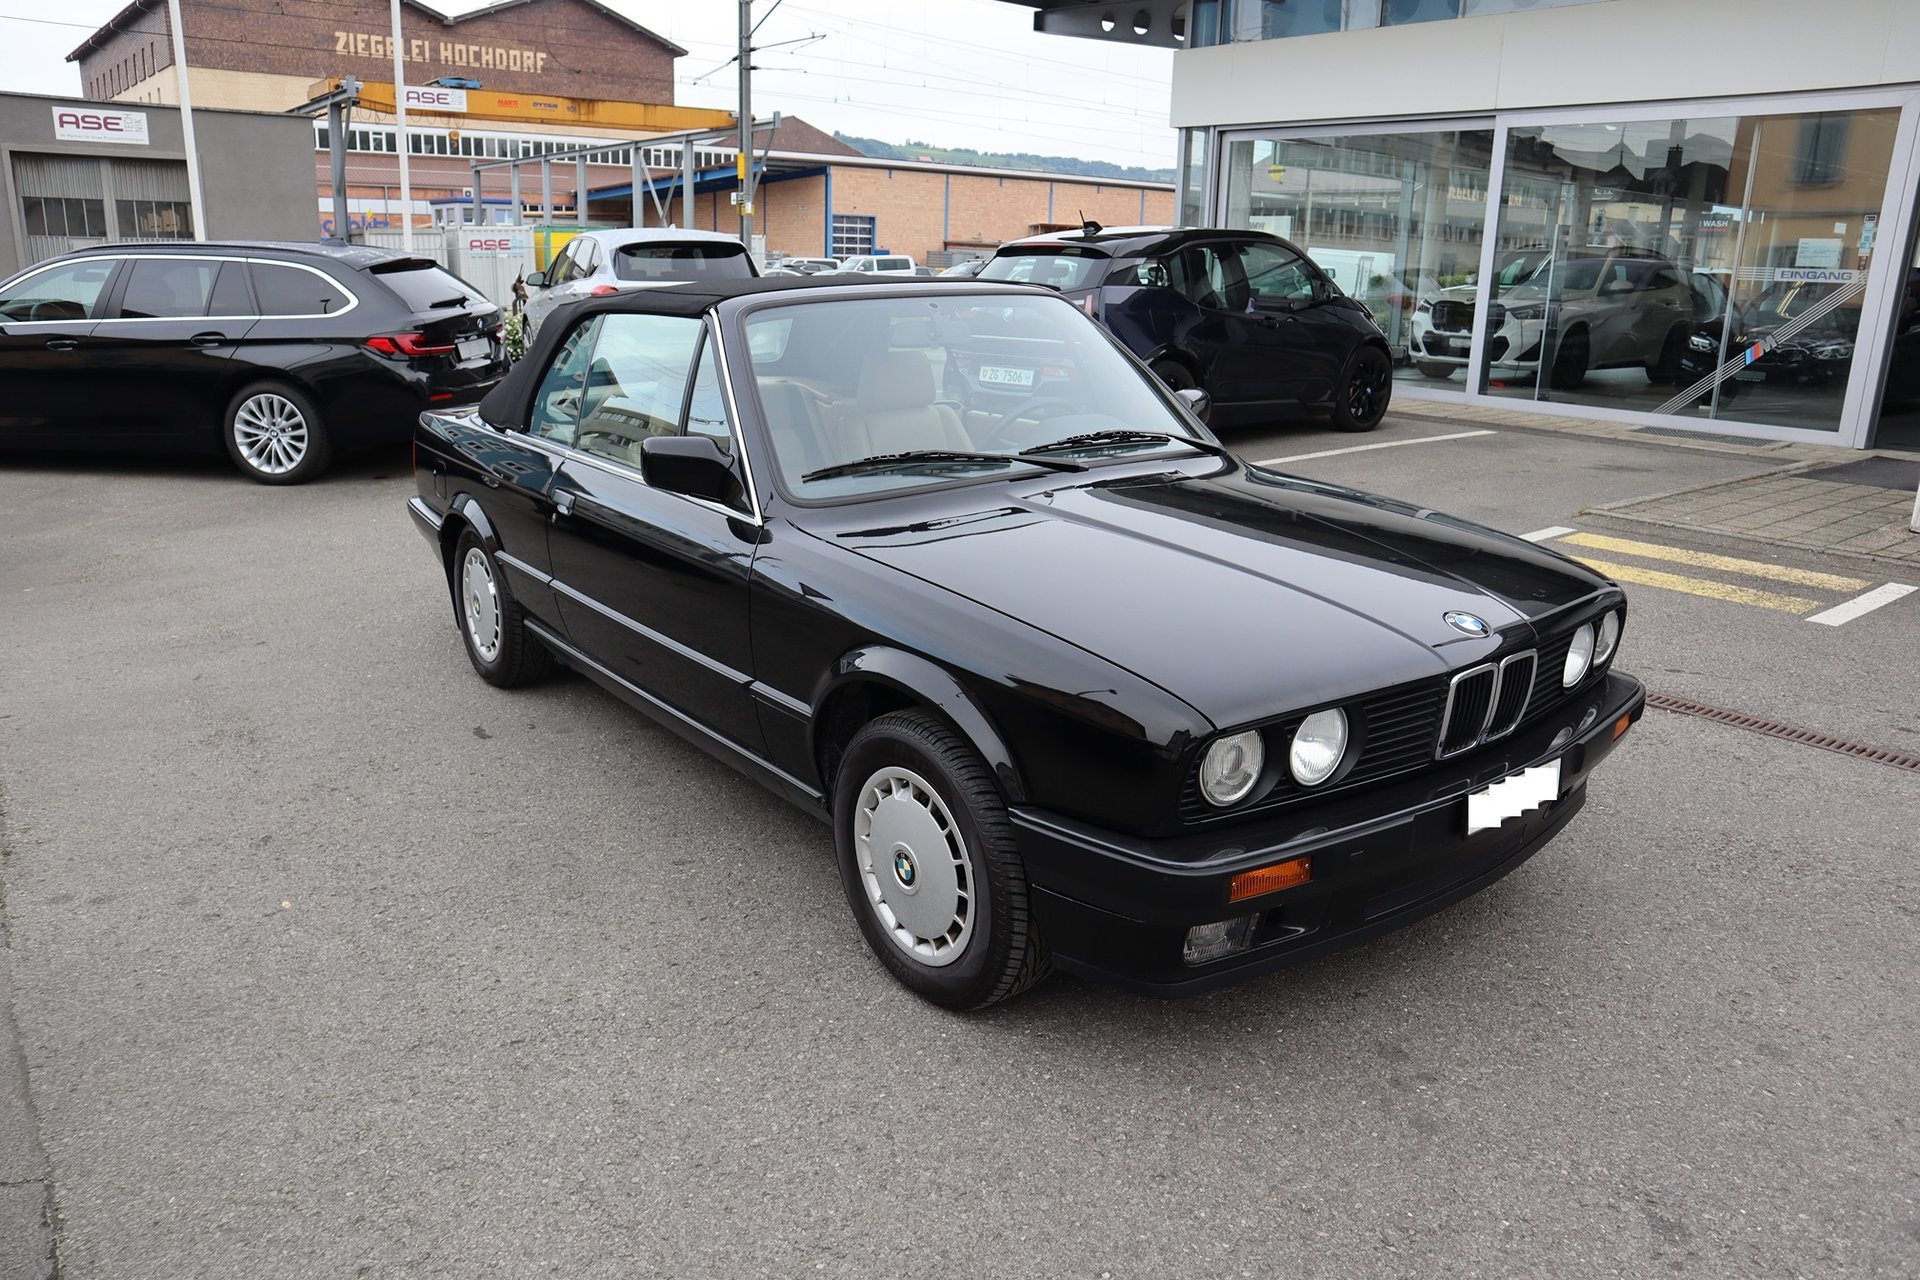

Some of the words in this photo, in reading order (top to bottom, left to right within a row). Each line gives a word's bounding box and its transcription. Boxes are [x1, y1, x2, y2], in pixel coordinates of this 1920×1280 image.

[440, 42, 547, 73] HOCHDORF
[406, 90, 450, 105] ASE
[58, 113, 124, 131] ASE
[1703, 219, 1729, 228] WASH
[469, 239, 512, 251] ASE
[1780, 270, 1853, 281] EINGANG
[1003, 370, 1022, 383] 7506
